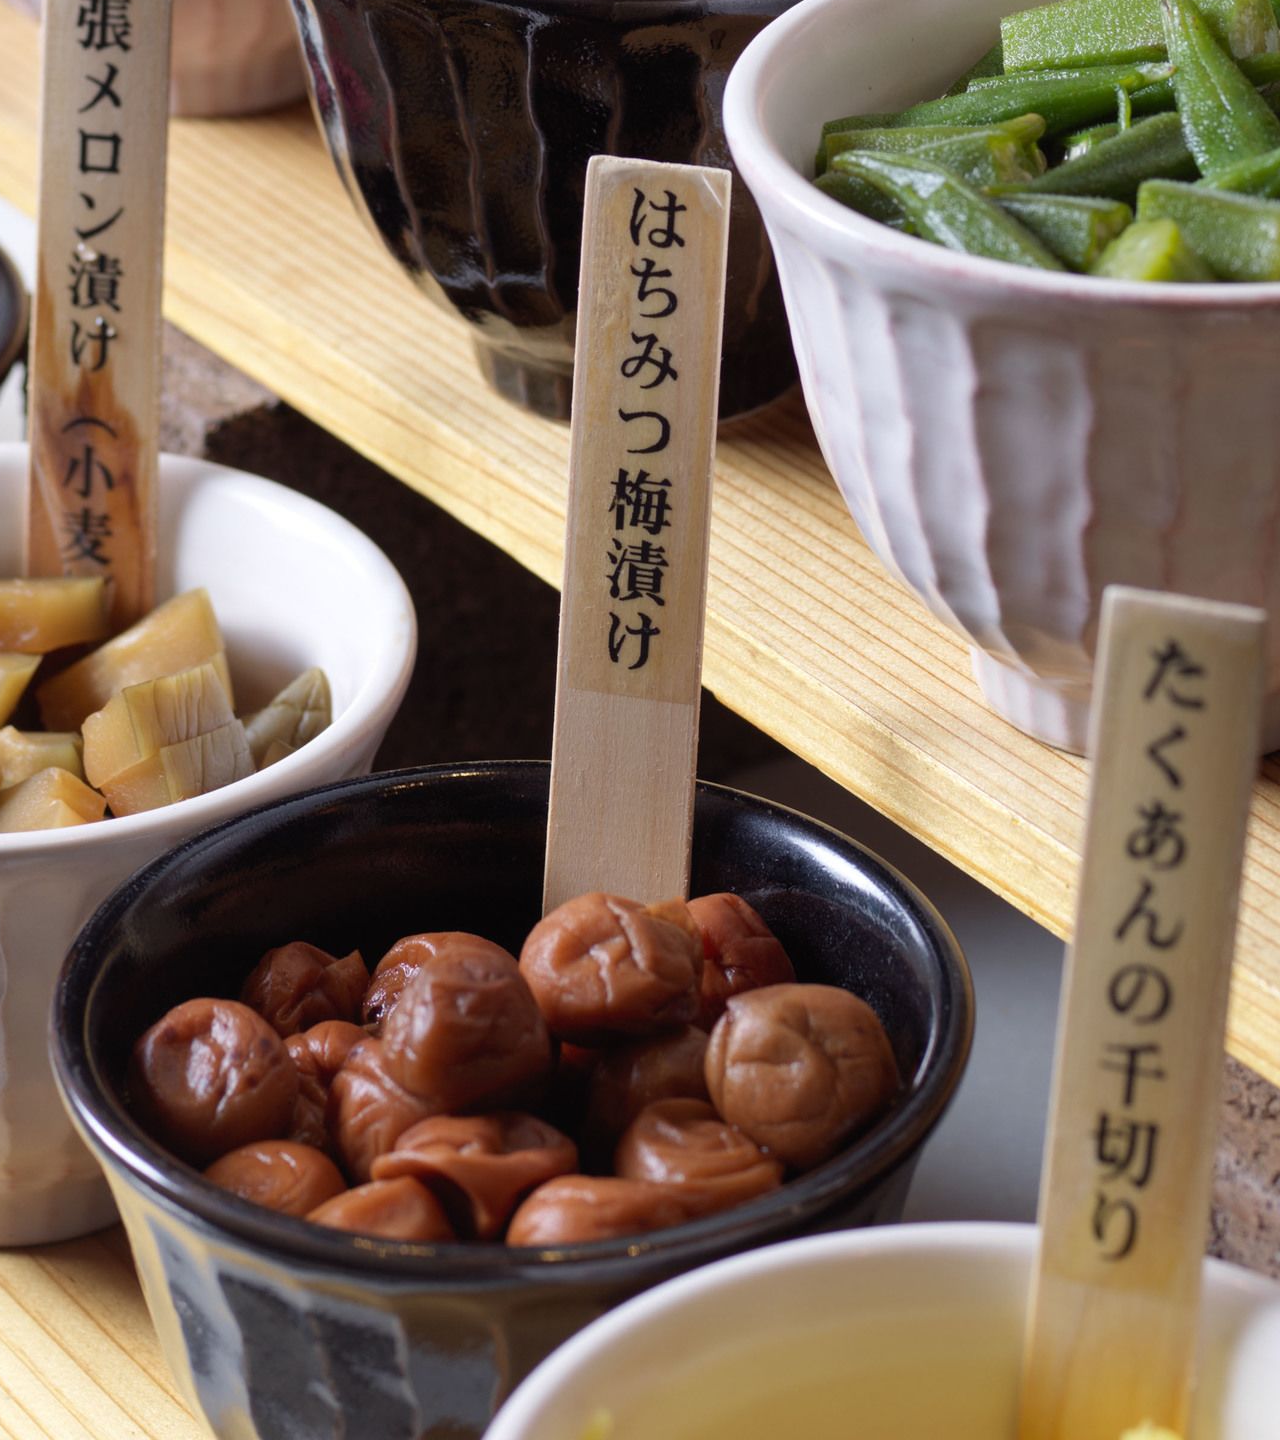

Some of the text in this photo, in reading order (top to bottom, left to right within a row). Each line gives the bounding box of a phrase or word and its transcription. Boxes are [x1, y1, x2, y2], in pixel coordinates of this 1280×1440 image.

[604, 187, 688, 671] はちみつ梅漬け
[1091, 636, 1208, 1262] たくあんの千切り
